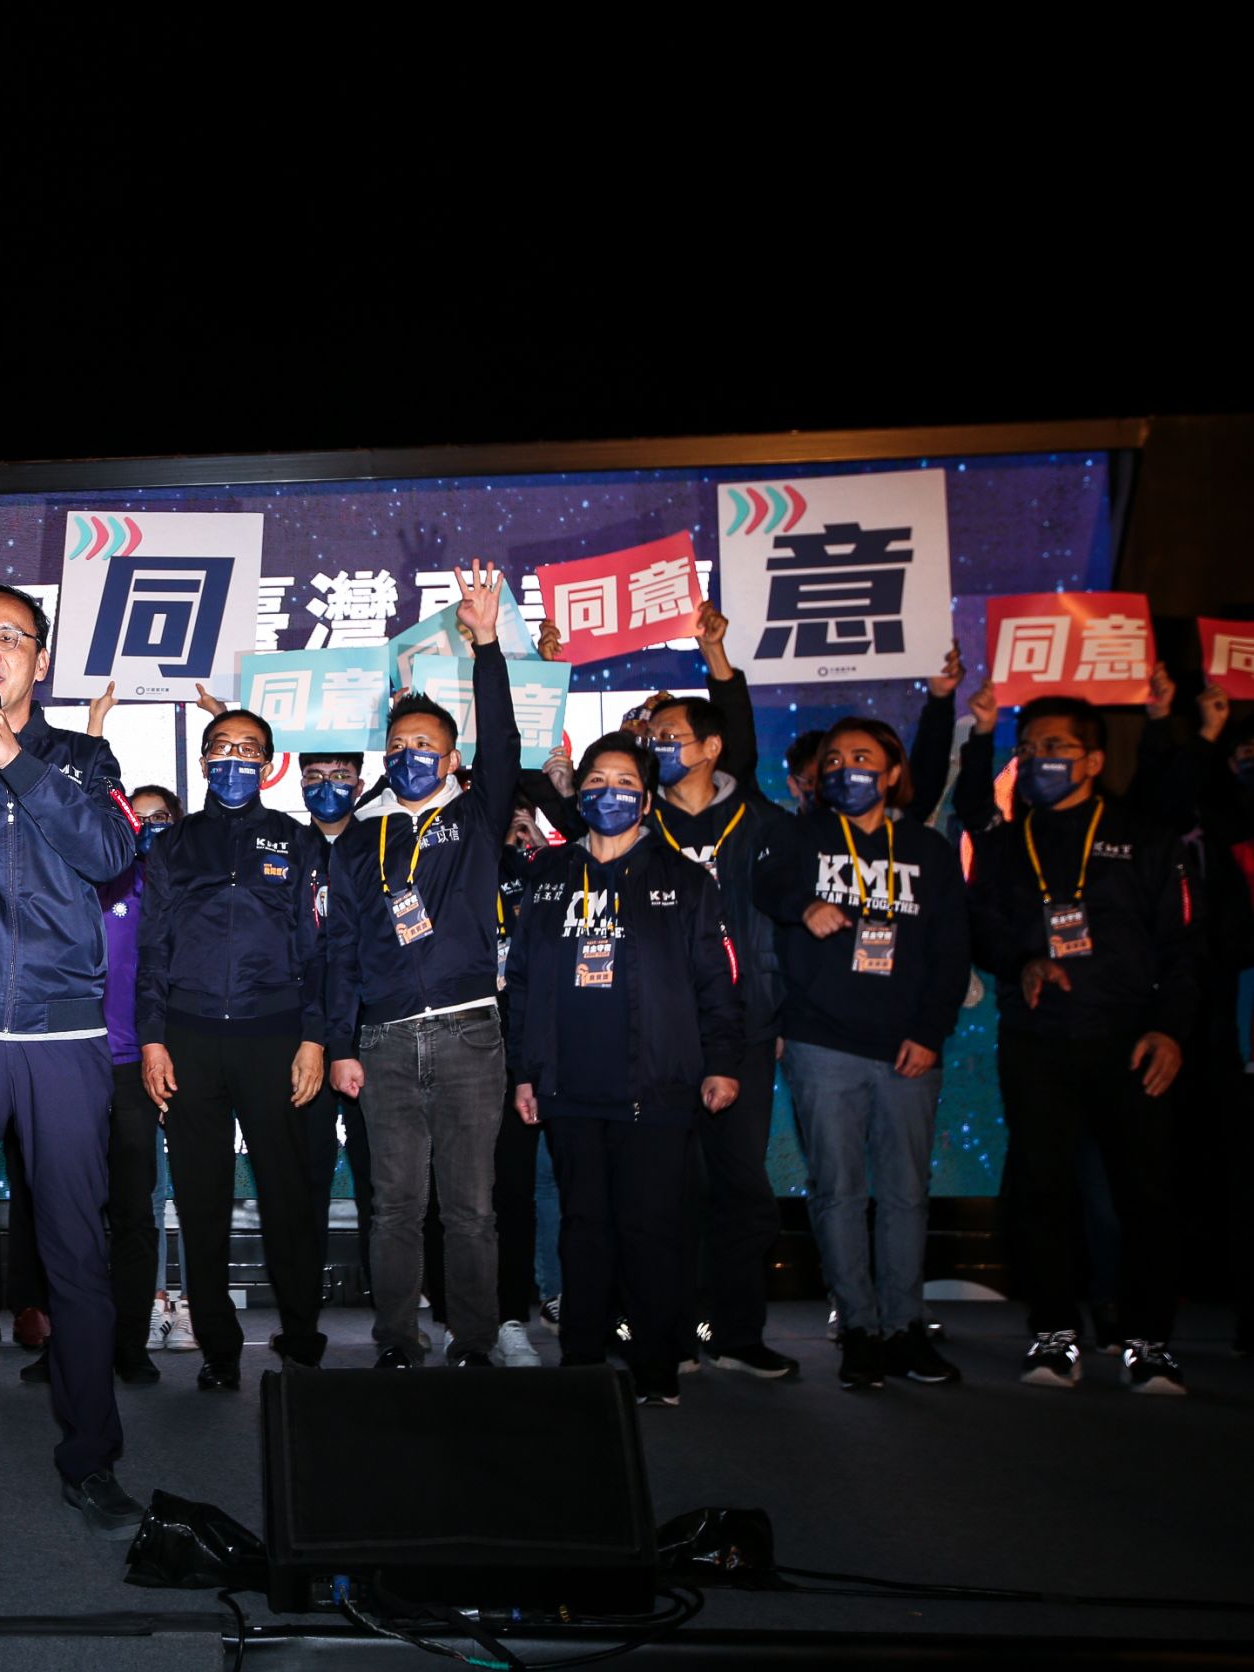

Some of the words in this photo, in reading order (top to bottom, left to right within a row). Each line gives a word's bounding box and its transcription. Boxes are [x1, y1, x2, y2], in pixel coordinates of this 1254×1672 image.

[84, 556, 235, 678] 同
[554, 557, 694, 645] 同意
[753, 522, 914, 660] 意
[992, 614, 1147, 683] 同意
[248, 668, 385, 731] 同意
[59, 764, 83, 779] MT
[256, 837, 289, 850] KMT
[650, 889, 676, 901] KM
[816, 851, 920, 901] KMT
